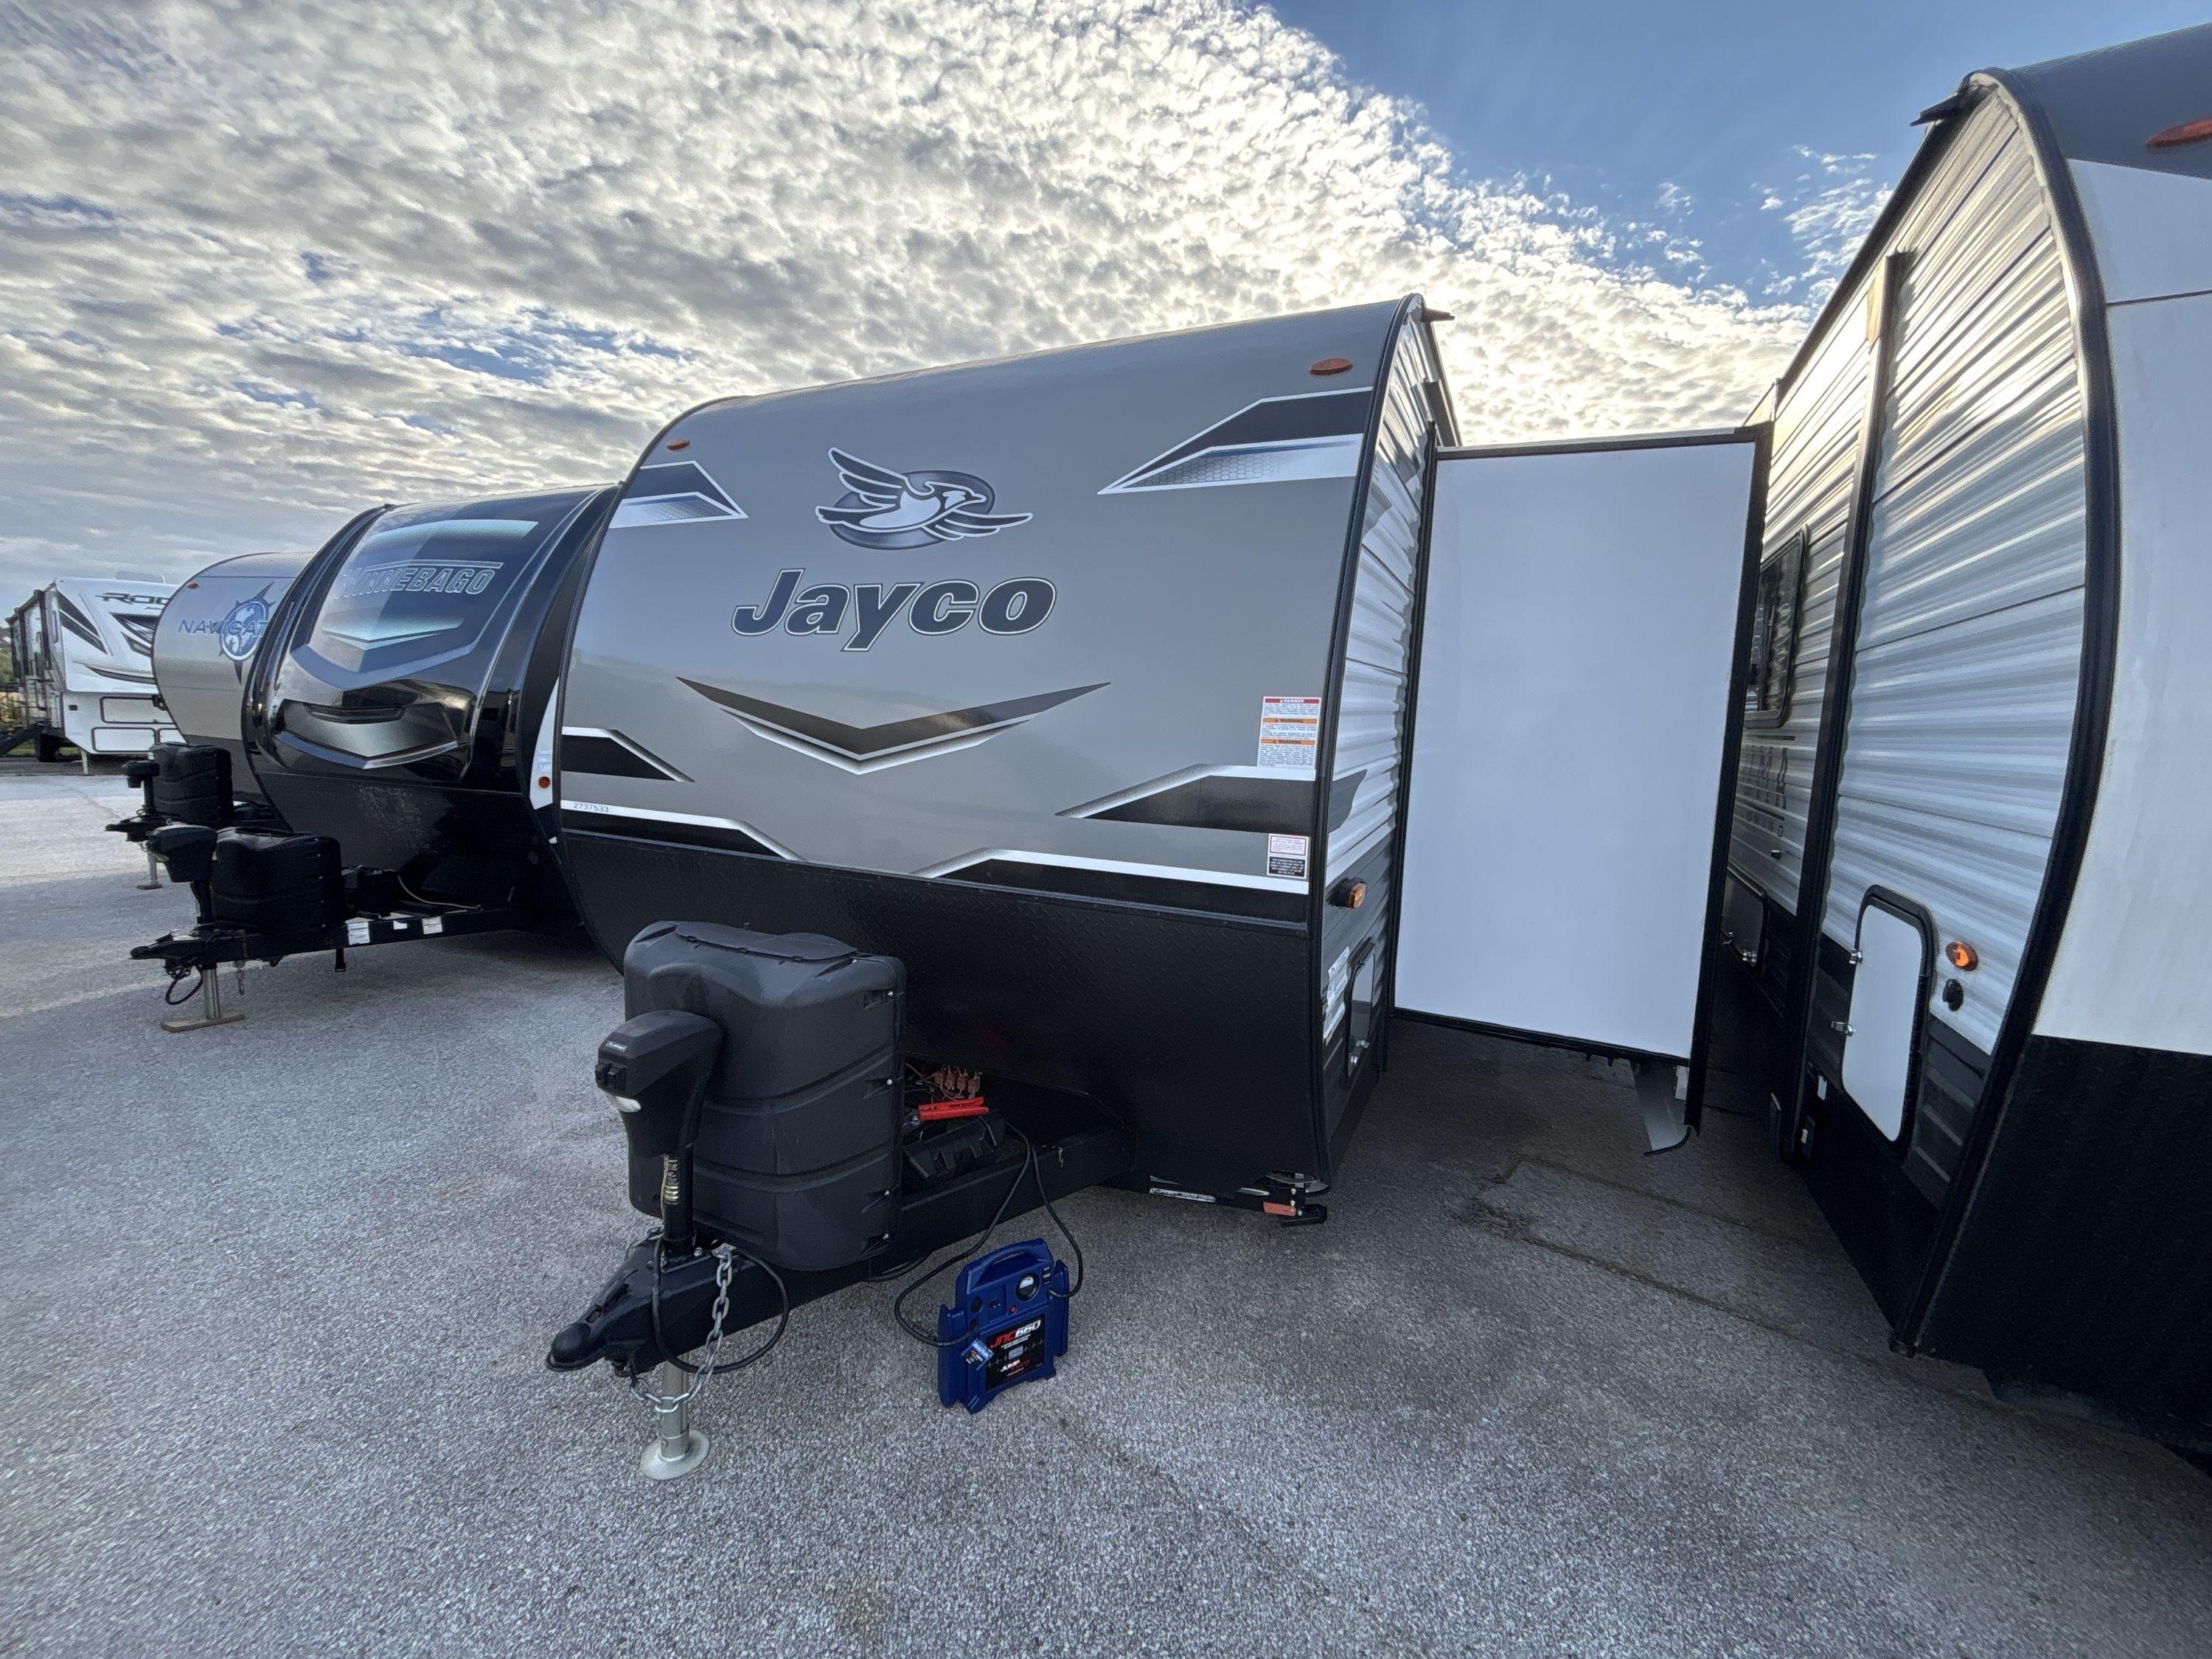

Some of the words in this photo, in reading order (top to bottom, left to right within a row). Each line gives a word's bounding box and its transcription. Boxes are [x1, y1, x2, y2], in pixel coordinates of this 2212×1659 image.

[333, 567, 495, 599] WINNEBAGO
[731, 568, 1057, 653] Jayco
[574, 803, 609, 813] 2737533
